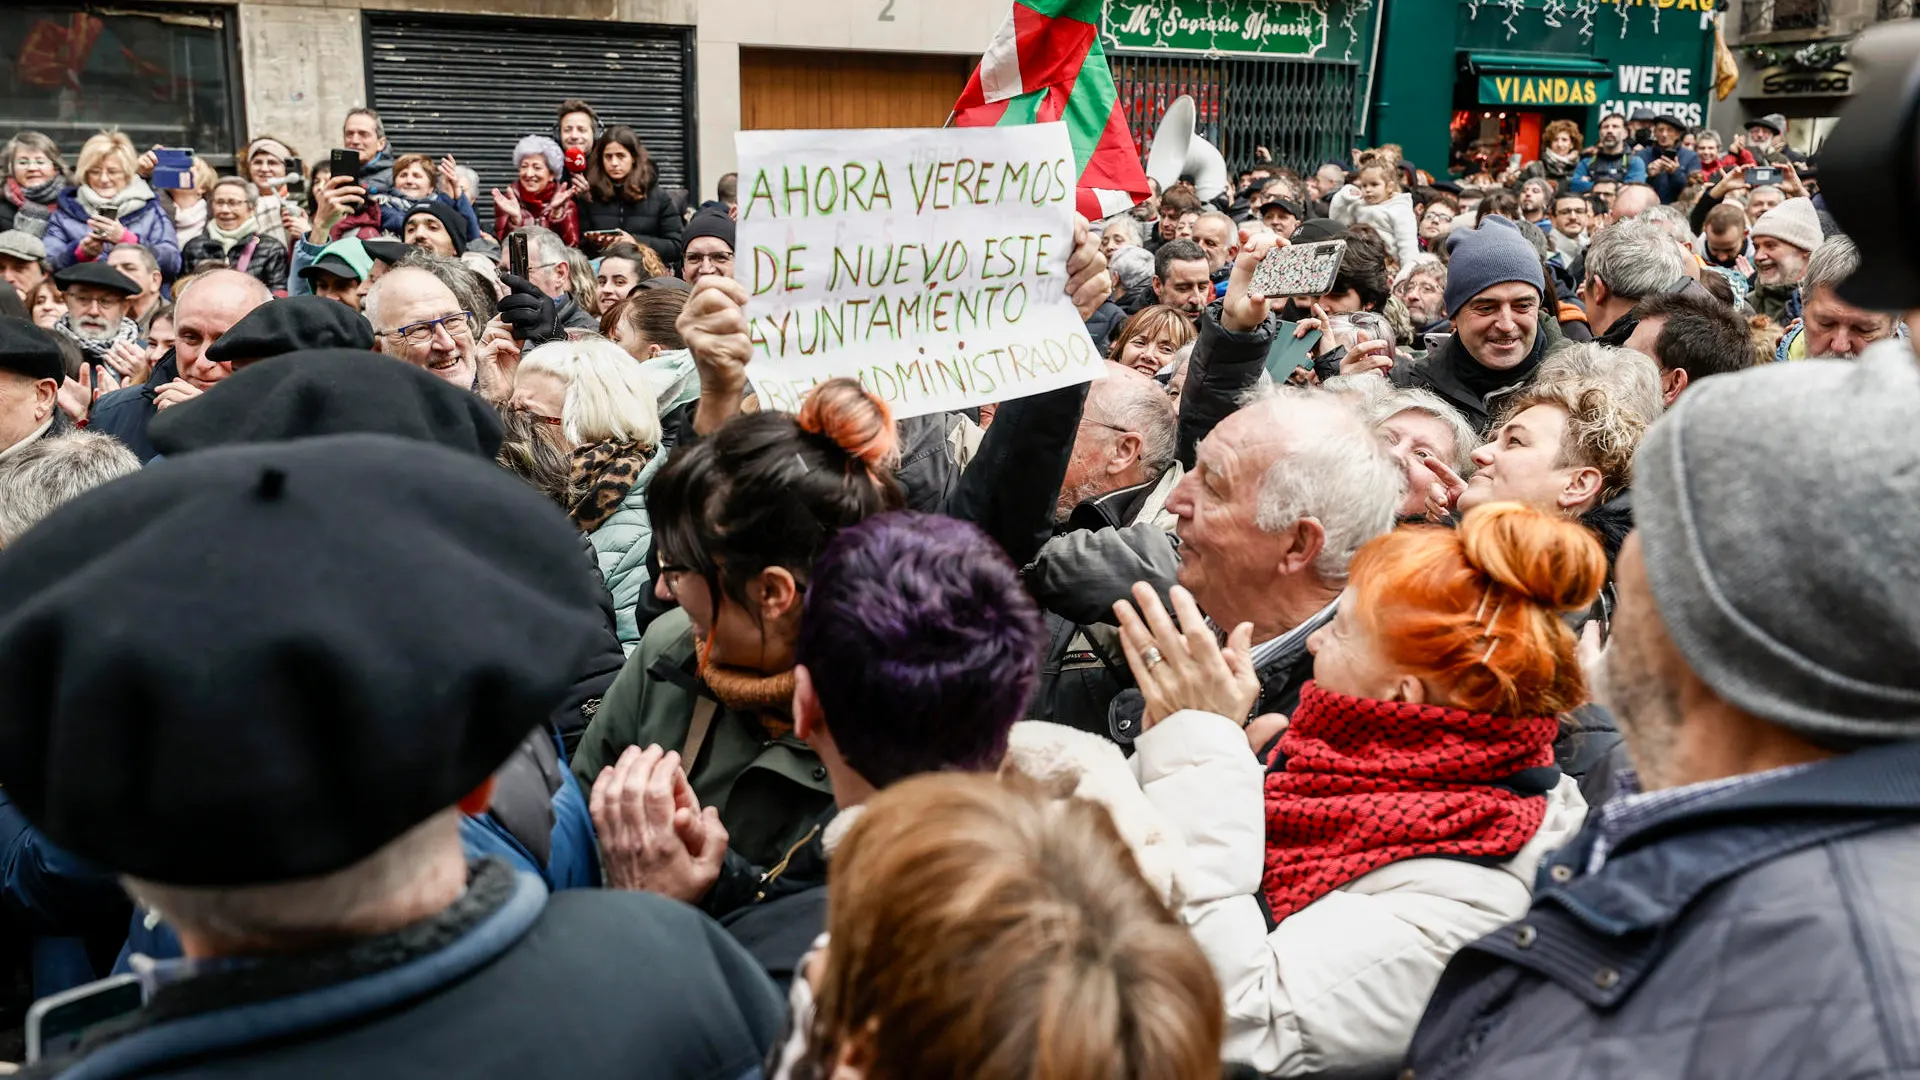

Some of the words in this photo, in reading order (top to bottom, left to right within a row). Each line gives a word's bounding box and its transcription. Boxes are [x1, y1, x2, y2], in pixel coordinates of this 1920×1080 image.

[877, 0, 895, 21] 2
[1495, 77, 1597, 104] VIANDAS
[1618, 65, 1691, 95] WE'RE
[744, 160, 892, 221] AHORA
[908, 158, 1066, 216] VEREMOS
[752, 243, 807, 296] DE
[830, 240, 968, 292] NUEVO
[981, 234, 1052, 280] ESTE
[749, 282, 1028, 357] AYUNTAMIENTO
[758, 374, 836, 413] BIE
